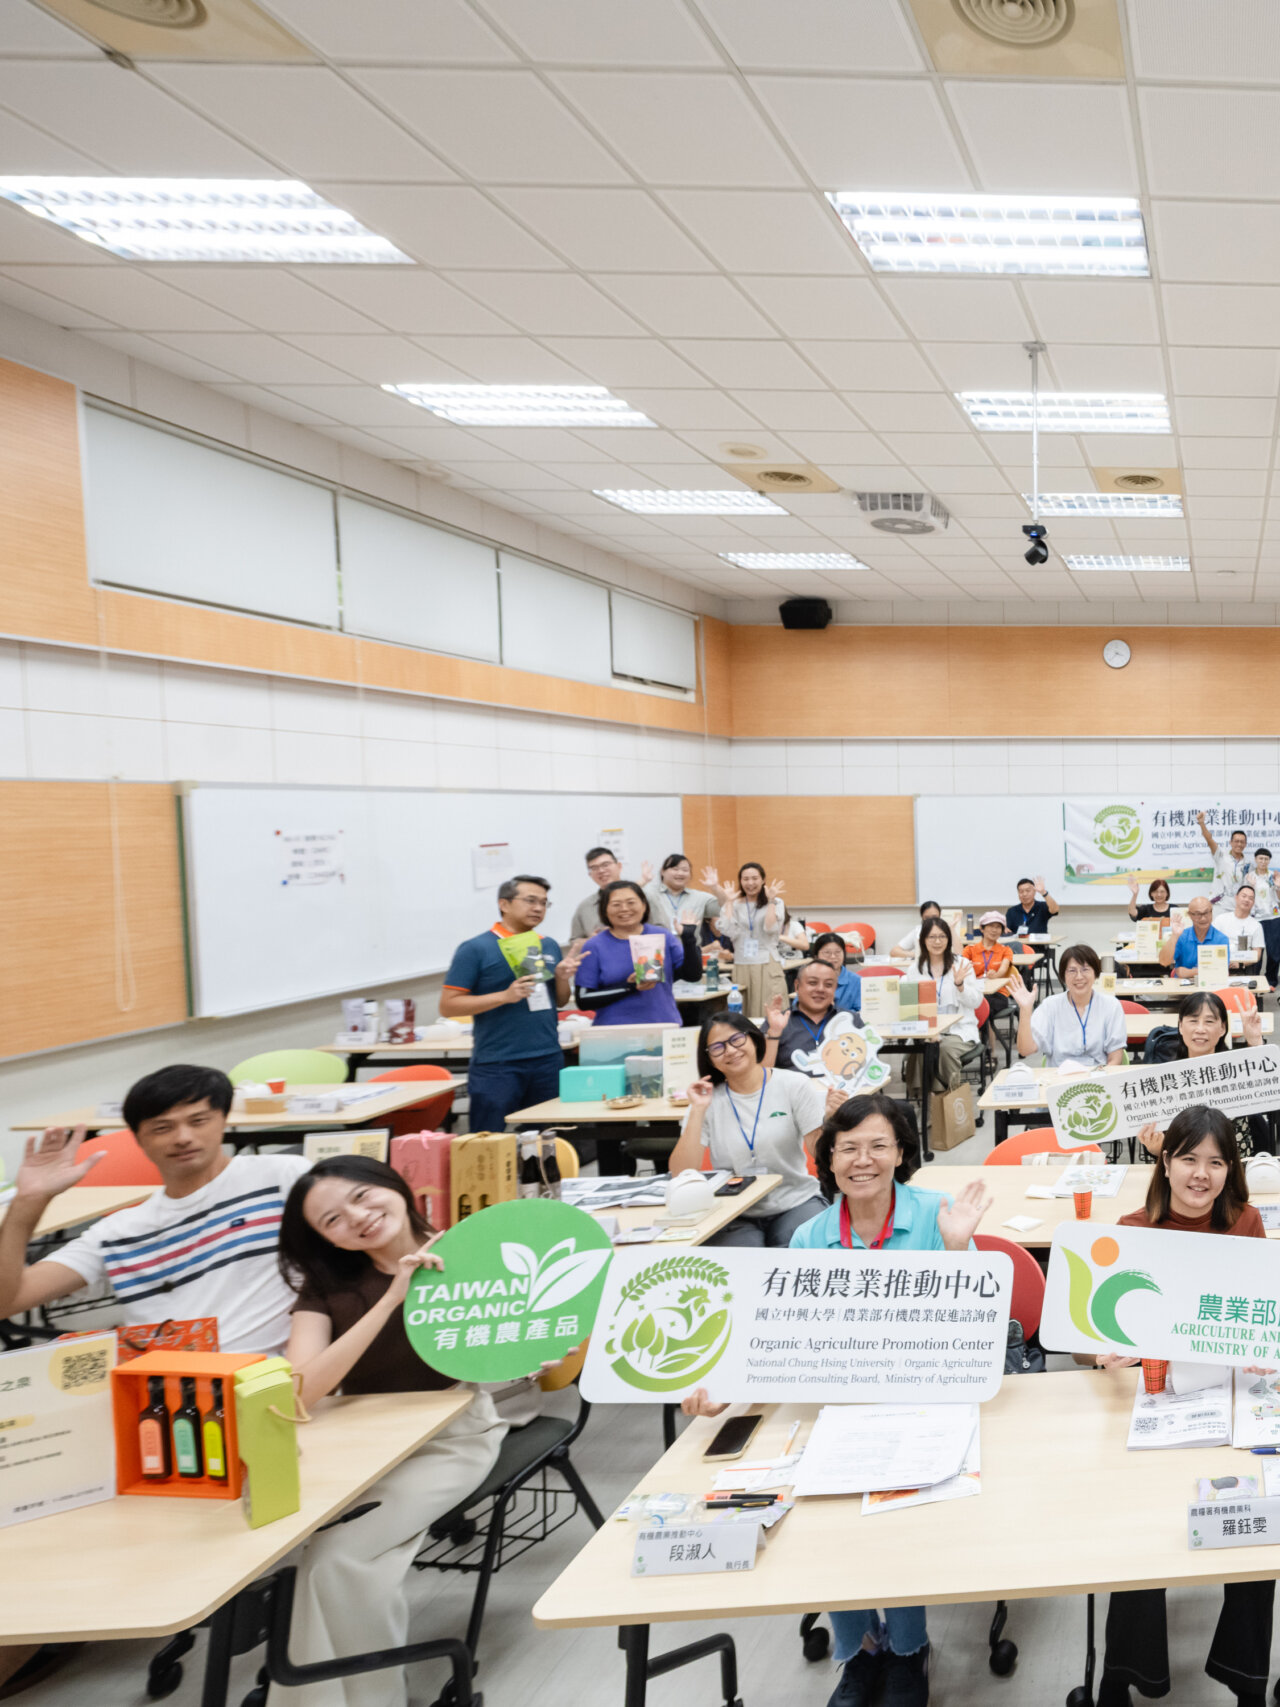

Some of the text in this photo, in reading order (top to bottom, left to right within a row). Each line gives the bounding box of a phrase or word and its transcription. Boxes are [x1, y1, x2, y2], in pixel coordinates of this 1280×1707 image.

[1152, 841, 1179, 851] Organic
[1120, 1056, 1278, 1099] 有機農業推動中心
[1124, 1095, 1173, 1112] 國立中興大學
[1126, 1109, 1159, 1123] Organic
[1209, 1093, 1252, 1107] Promotion
[414, 1277, 529, 1304] TAIWAN
[761, 1267, 1000, 1299] 有機農業推動中心
[407, 1300, 527, 1326] ORGANIC
[755, 1307, 998, 1323] 國立中興大學 農業部有機農業促進諮詢會
[433, 1315, 578, 1351] 有機農產品
[1171, 1322, 1255, 1342] AGRICULTURE
[750, 1337, 995, 1353] Organic Agriculture Promotion Center
[1190, 1340, 1247, 1357] MINISTRY
[1253, 1345, 1270, 1358] OF
[746, 1357, 992, 1370] National Chung Hsing University Organic Agriculture
[746, 1373, 987, 1386] Promotion Consulting Board, Ministry of Agriculture
[1222, 1517, 1267, 1536] 羅鈺雯
[669, 1542, 716, 1562] 段淑人
